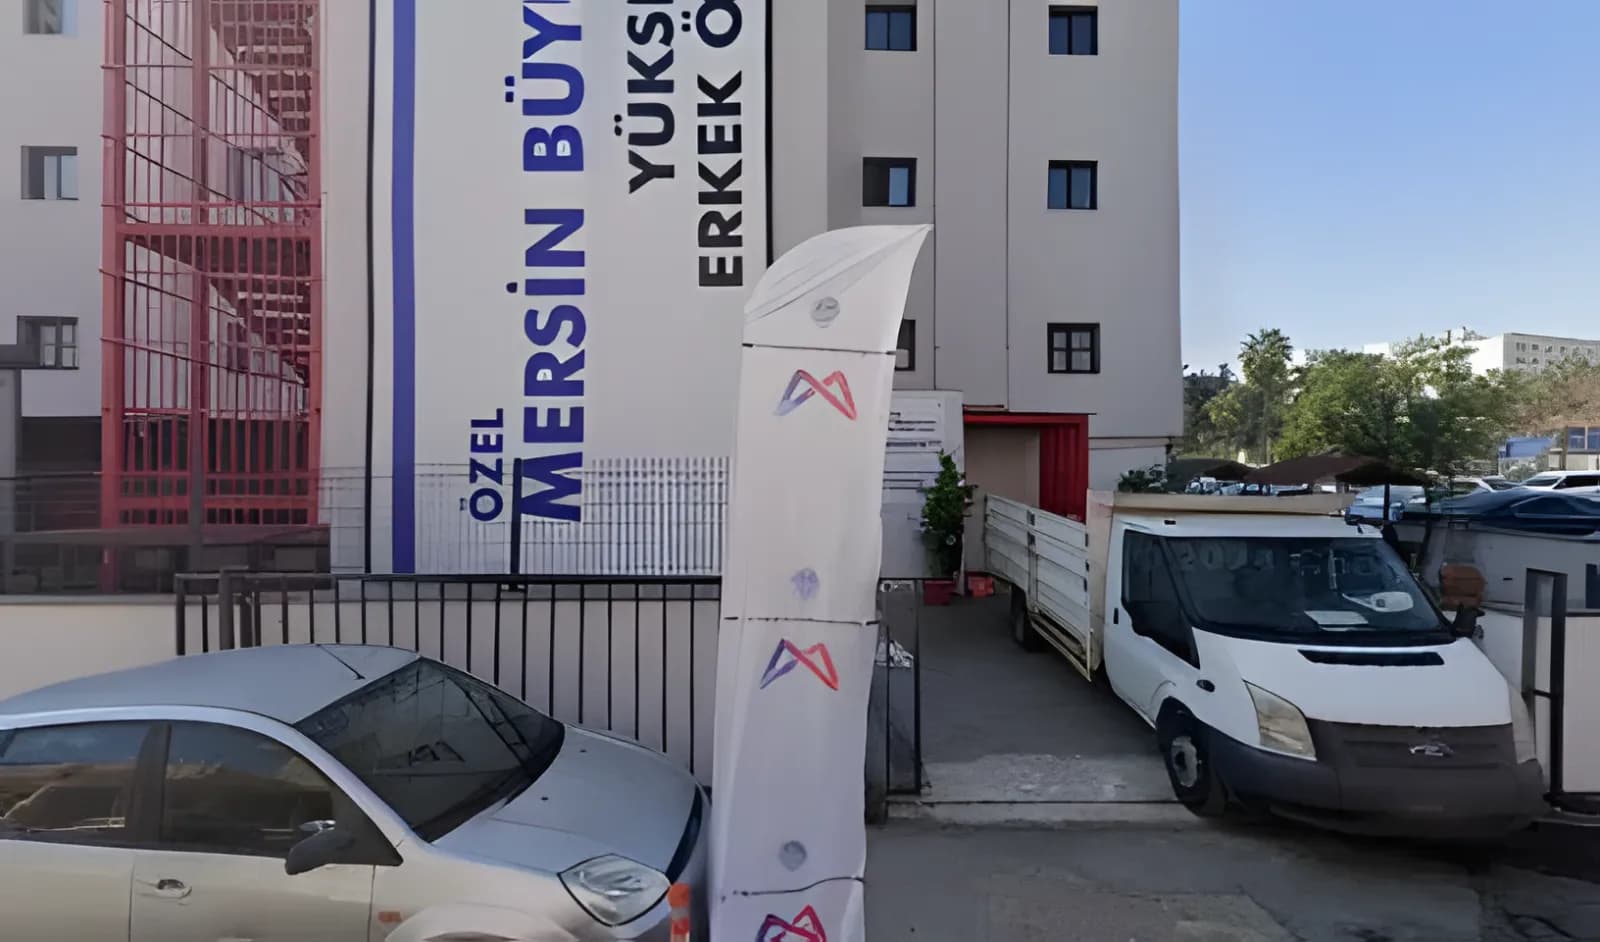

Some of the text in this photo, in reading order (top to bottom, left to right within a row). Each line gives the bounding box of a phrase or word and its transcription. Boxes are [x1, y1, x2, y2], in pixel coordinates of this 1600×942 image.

[614, 0, 675, 194] YÜKS
[697, 70, 743, 286] ERKEK
[505, 0, 586, 522] MERSİN BÜY
[460, 408, 503, 521] ÖZEL
